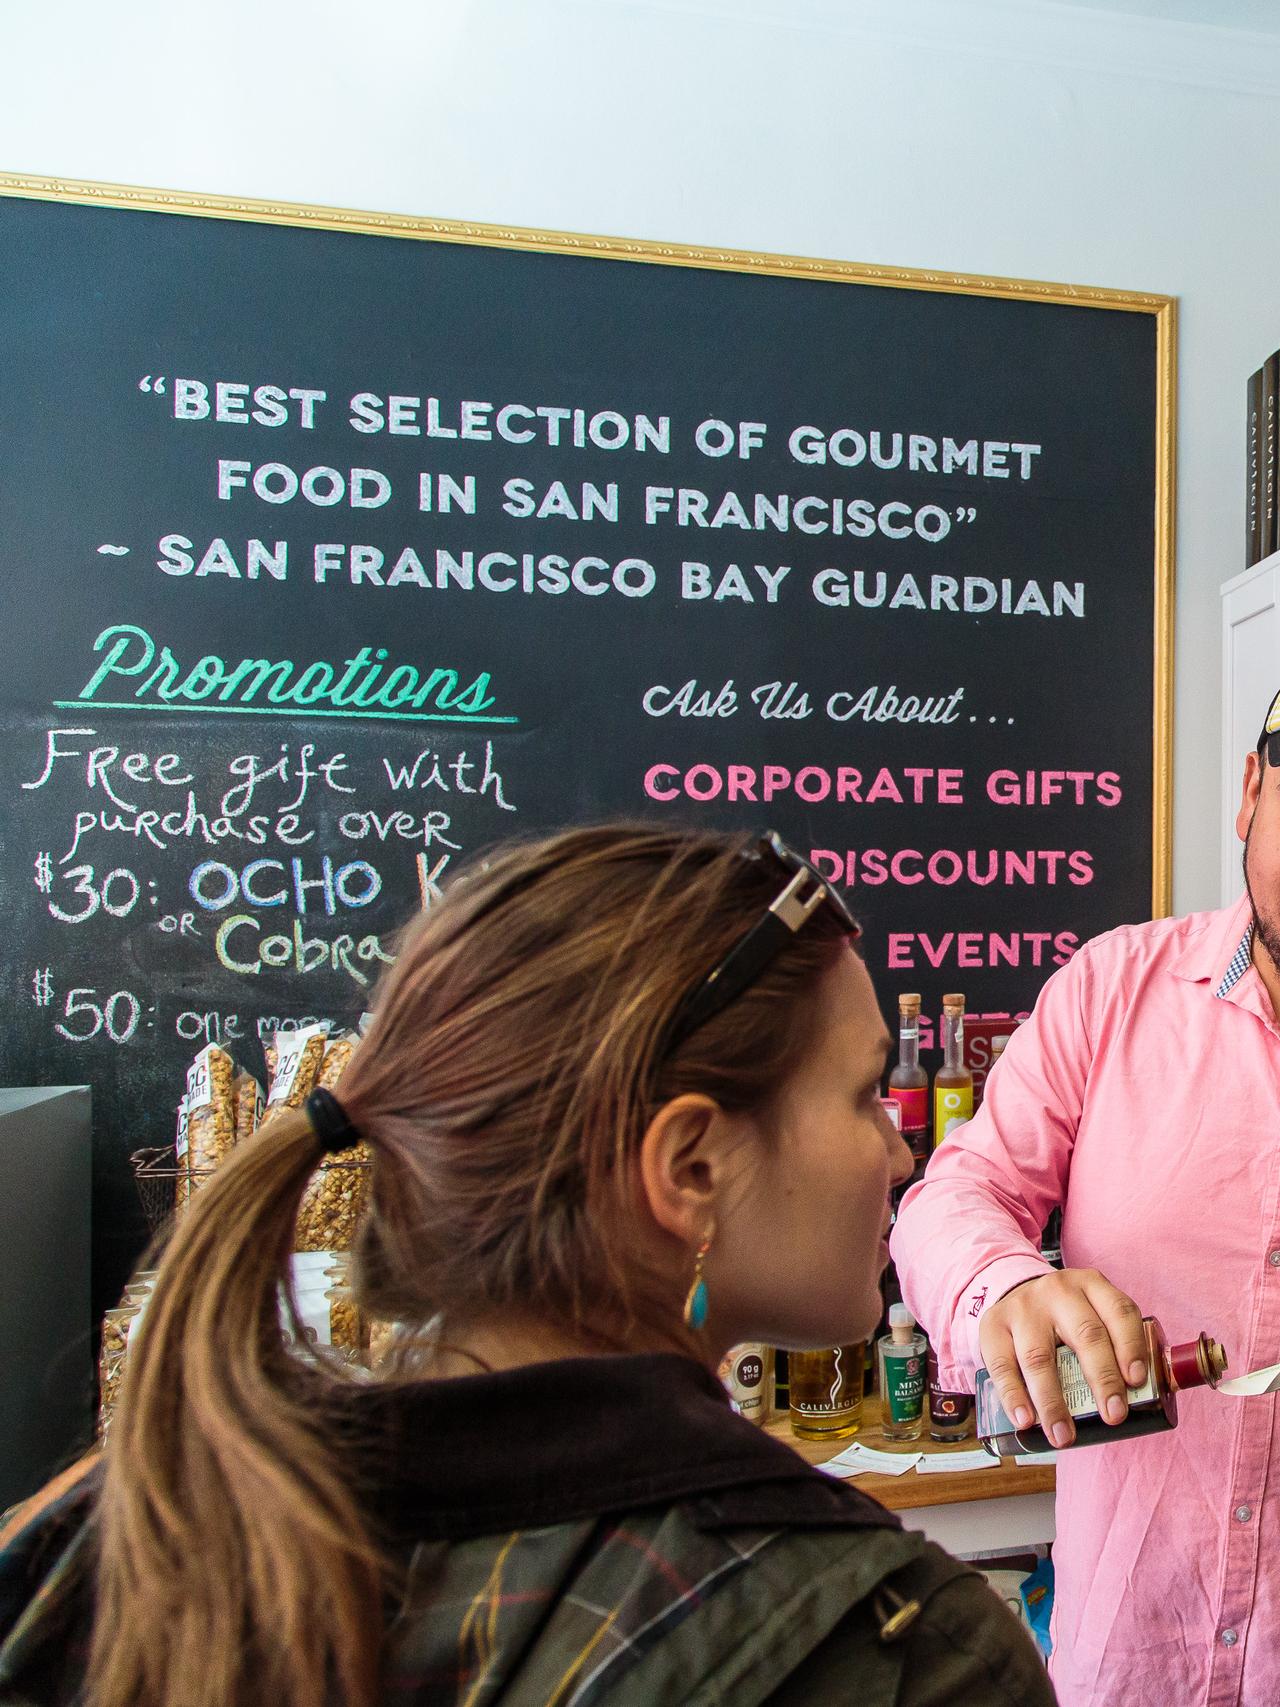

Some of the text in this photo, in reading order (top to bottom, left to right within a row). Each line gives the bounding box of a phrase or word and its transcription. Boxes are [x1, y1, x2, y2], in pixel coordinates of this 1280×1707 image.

[349, 392, 671, 453] SELECTION
[694, 418, 767, 460] OF
[788, 425, 1042, 480] GOURMET
[217, 459, 392, 509] FOOD
[418, 472, 476, 515] IN
[502, 477, 619, 522] SAN
[156, 533, 288, 581] SAN
[313, 543, 657, 598] FRANCISCO
[681, 561, 792, 603] BAY
[811, 568, 1085, 618] GUARDIAN
[79, 624, 497, 712] Promotions
[642, 679, 739, 718] Ask
[750, 681, 813, 720] Us
[221, 744, 356, 817] gift
[383, 741, 518, 812] with
[643, 763, 1122, 807] CORPORATE GIFTS
[189, 855, 382, 916] OCHO
[810, 849, 1095, 887] DISCOUNTS
[888, 932, 1079, 969] EVENTS
[176, 1011, 244, 1041] one
[894, 1385, 924, 1397] BALSAM
